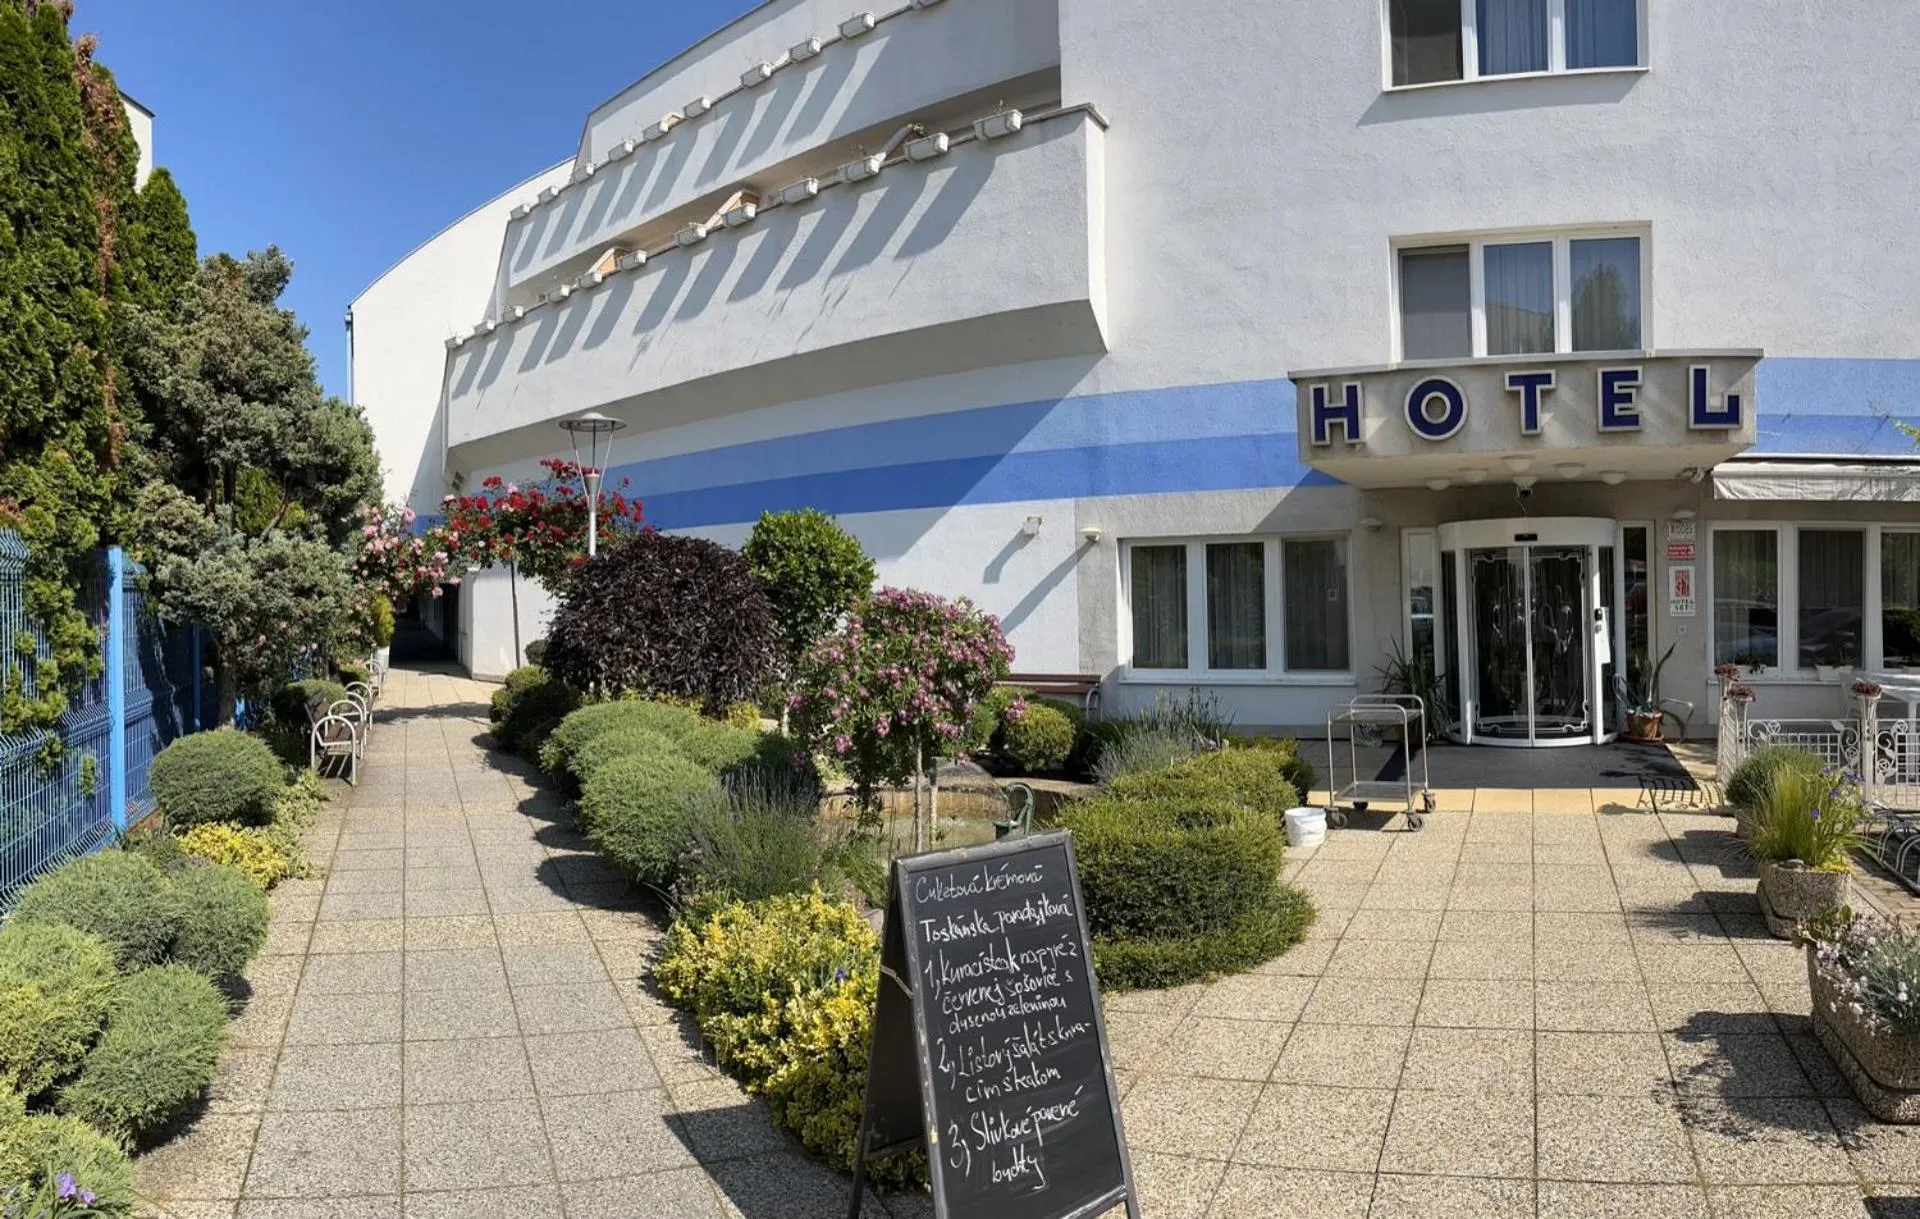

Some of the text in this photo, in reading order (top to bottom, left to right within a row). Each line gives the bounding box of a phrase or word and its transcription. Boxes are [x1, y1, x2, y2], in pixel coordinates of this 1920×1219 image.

[1309, 364, 1743, 446] HOTEL
[1065, 970, 1073, 982] s
[1007, 994, 1066, 1015] zeleninou
[959, 1036, 1013, 1076] Listový
[1047, 1031, 1058, 1045] s
[970, 1106, 1032, 1150] Slivkové
[992, 1143, 1046, 1189] buchty
